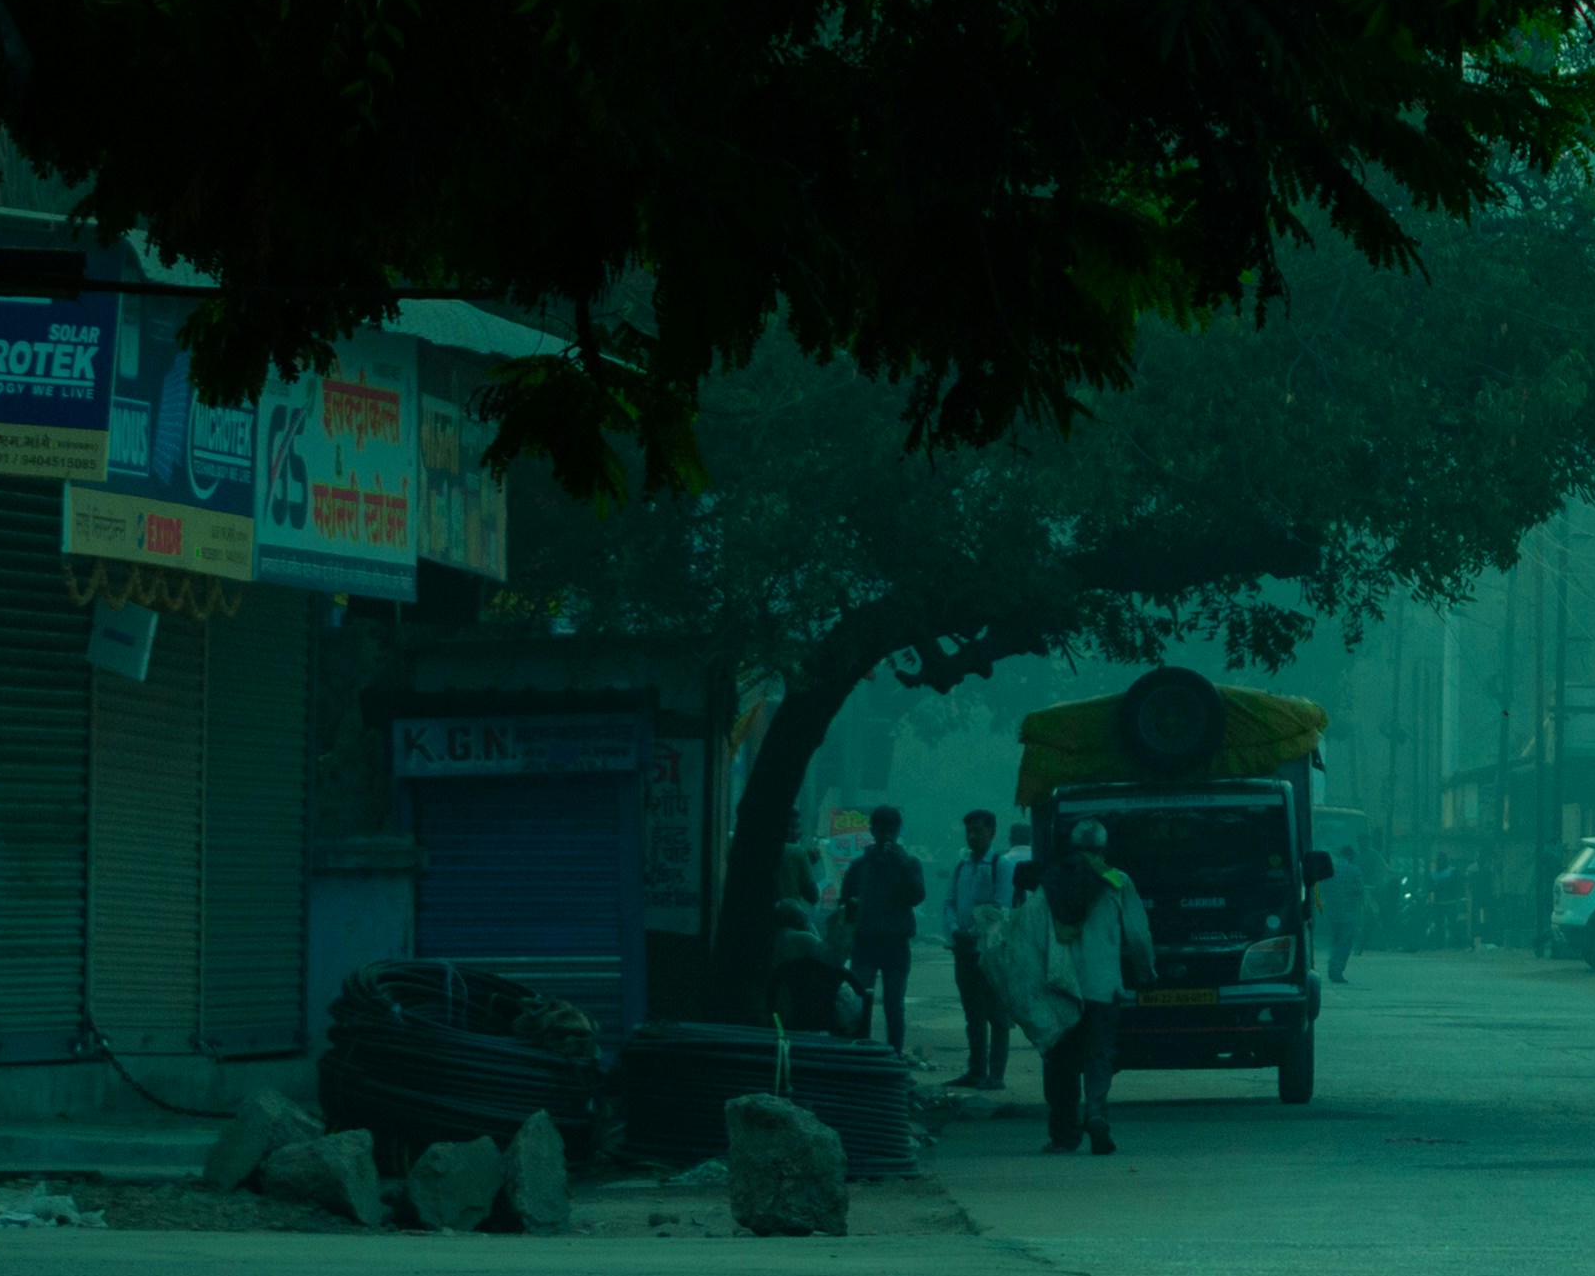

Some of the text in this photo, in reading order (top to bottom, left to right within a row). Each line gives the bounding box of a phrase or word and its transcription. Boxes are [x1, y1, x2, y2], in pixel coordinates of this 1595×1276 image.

[48, 324, 101, 345] SOLAR
[32, 384, 55, 397] WE
[60, 386, 94, 400] LIVE
[1180, 896, 1227, 910] CARRIER
